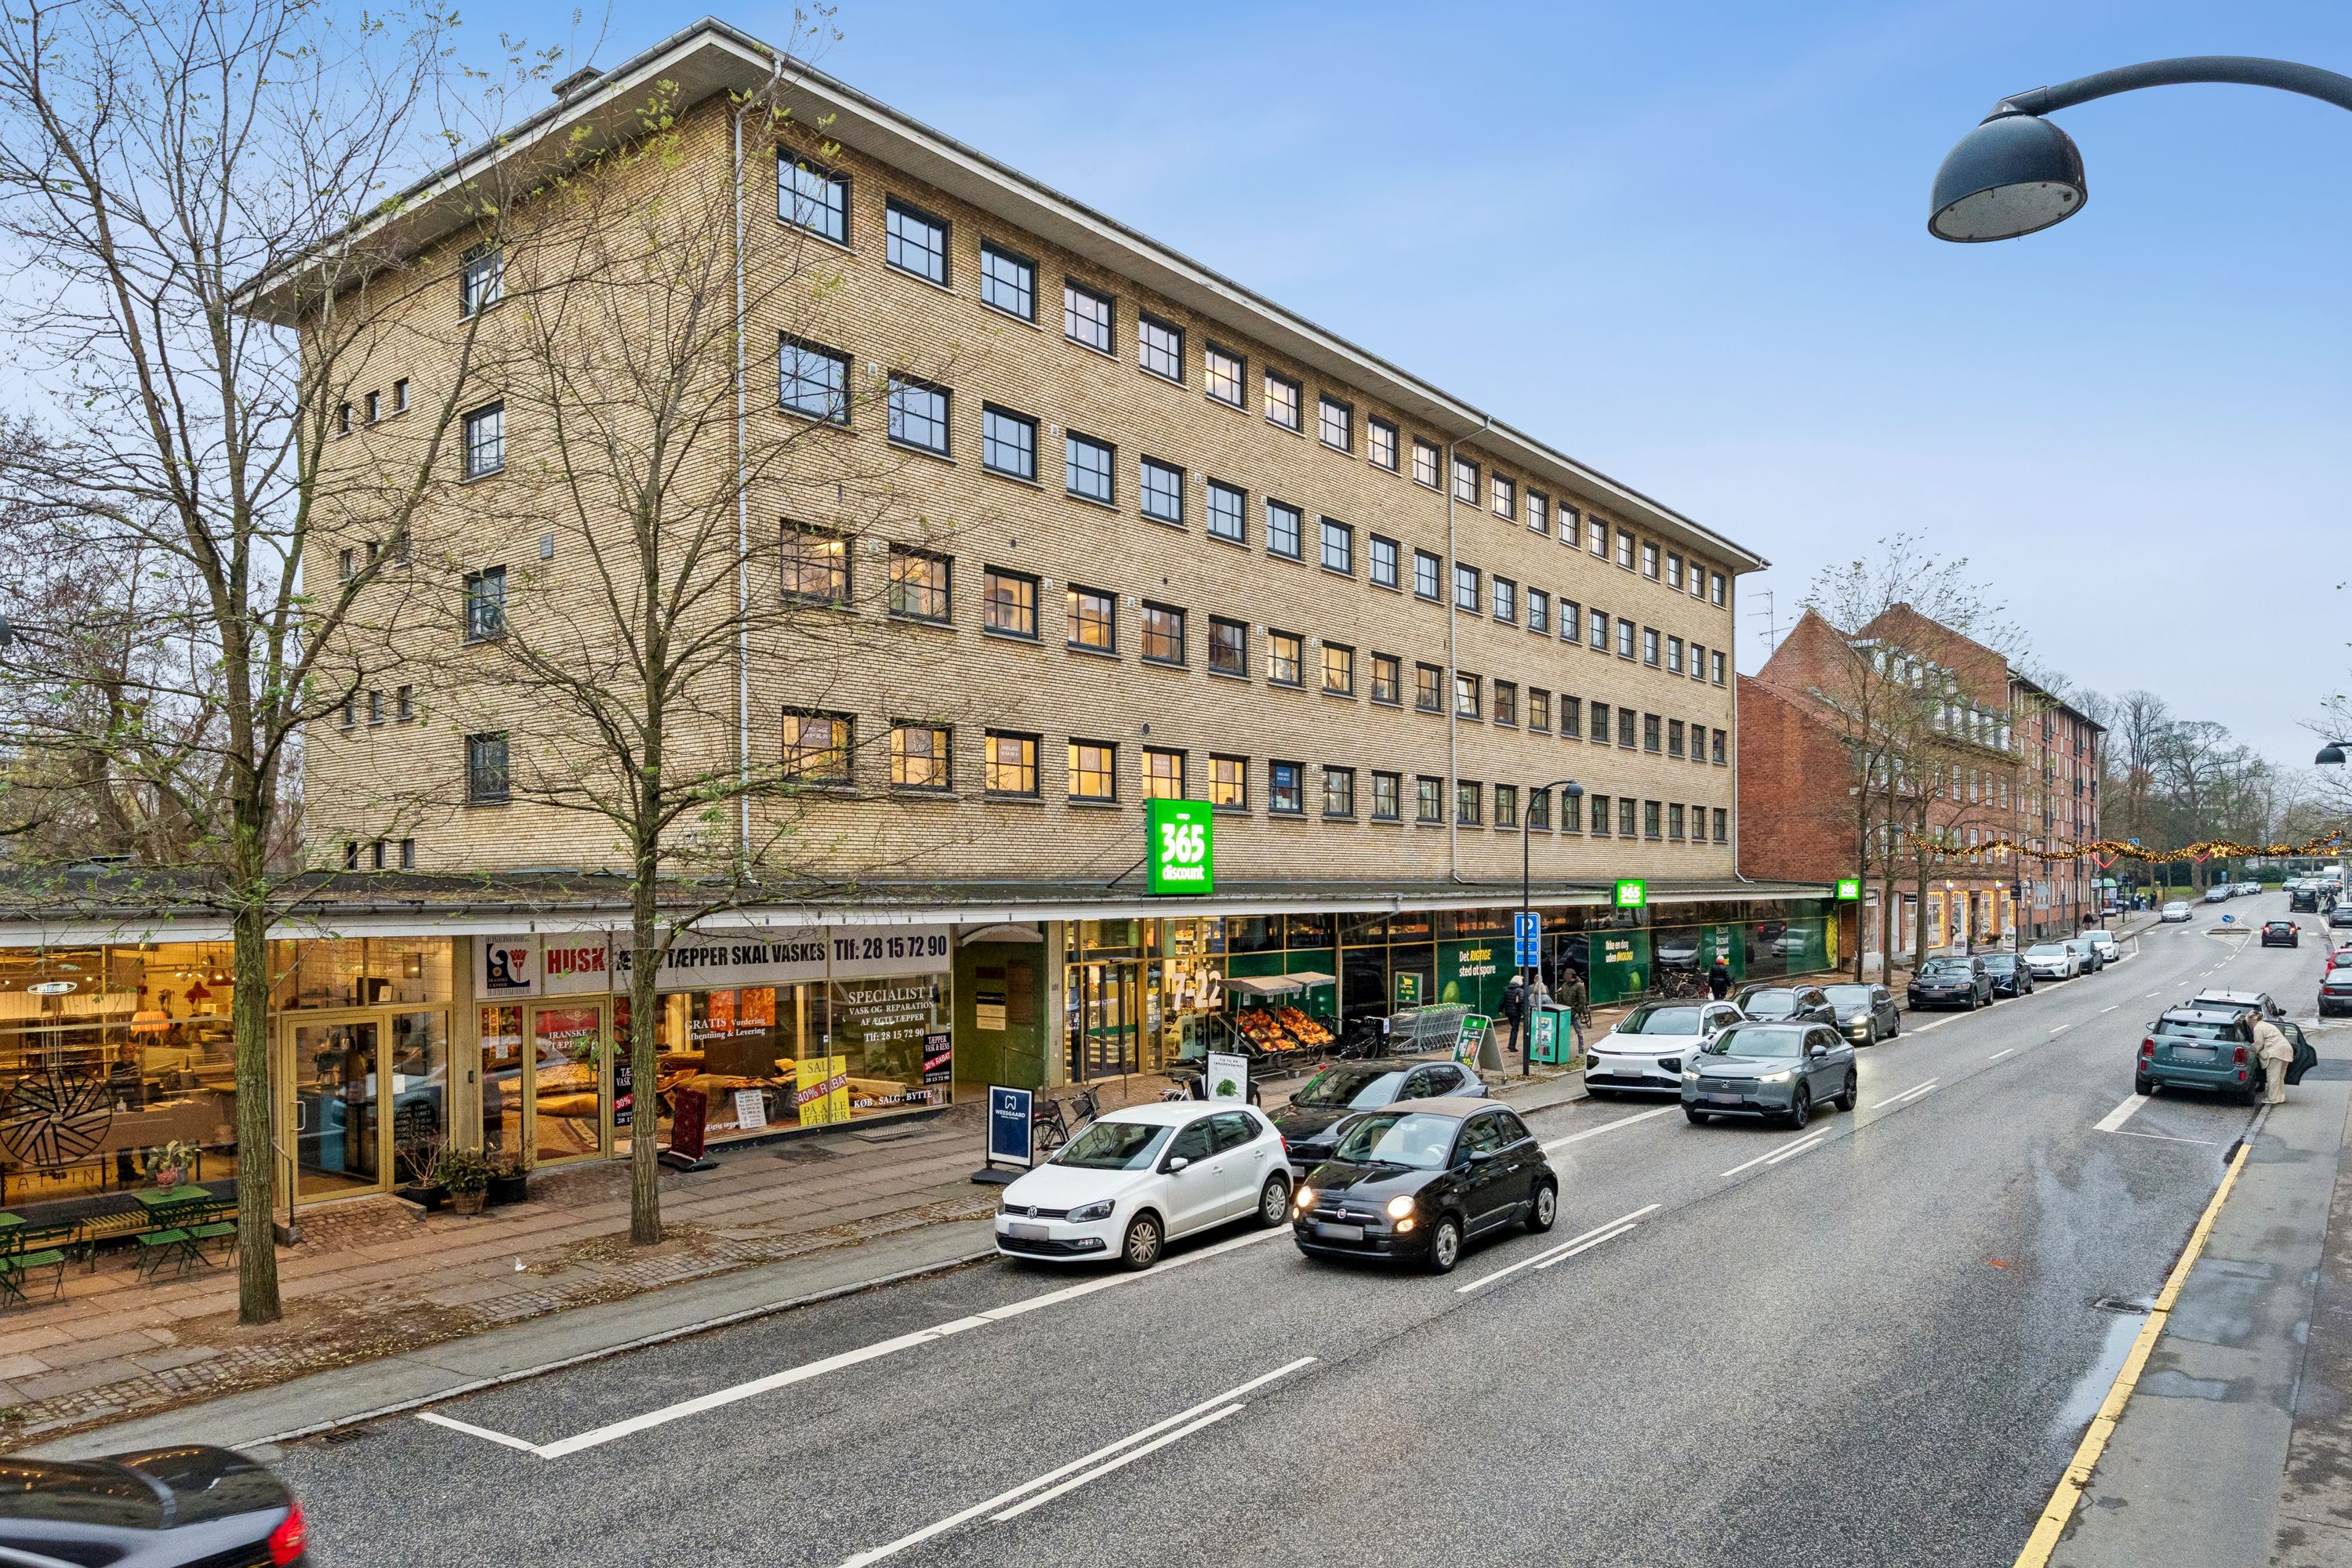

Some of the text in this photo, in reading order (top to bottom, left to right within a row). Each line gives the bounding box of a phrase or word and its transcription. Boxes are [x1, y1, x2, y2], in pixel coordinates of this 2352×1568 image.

[1162, 823, 1205, 863] 365
[1163, 864, 1205, 880] discount
[1621, 886, 1640, 898] 365
[1841, 884, 1857, 893] 365
[1522, 918, 1534, 936] P
[834, 935, 947, 960] Tlf: 28 15 72 90
[547, 947, 606, 974] HUSK
[668, 946, 728, 969] TÆPPER
[732, 945, 769, 965] SKAL
[772, 942, 825, 963] VASKES
[1459, 949, 1492, 962] Det RIGTIGE
[1459, 965, 1496, 977] sted at spare
[848, 986, 934, 1004] SPECIALIST I
[1172, 970, 1222, 1011] 7-22
[849, 1007, 869, 1015] VASK
[886, 1001, 934, 1012] REPARATION
[684, 1018, 726, 1029] GRATIS
[895, 1013, 924, 1023] TÆPPER
[549, 1029, 588, 1039] IRANSKE
[736, 1027, 766, 1036] Levering
[864, 1028, 924, 1042] Tlf: 28 15 72 90
[925, 1052, 950, 1070] 30% RABAT
[616, 1077, 631, 1087] VASK
[798, 1074, 847, 1103] 40% RBAT
[616, 1096, 631, 1108] 30%
[854, 1098, 872, 1108] KØB
[879, 1094, 900, 1105] SALG
[907, 1090, 933, 1100] BYTTE
[804, 1101, 846, 1116] PÅ ALE
[995, 1109, 1025, 1118] WEESGAARD
